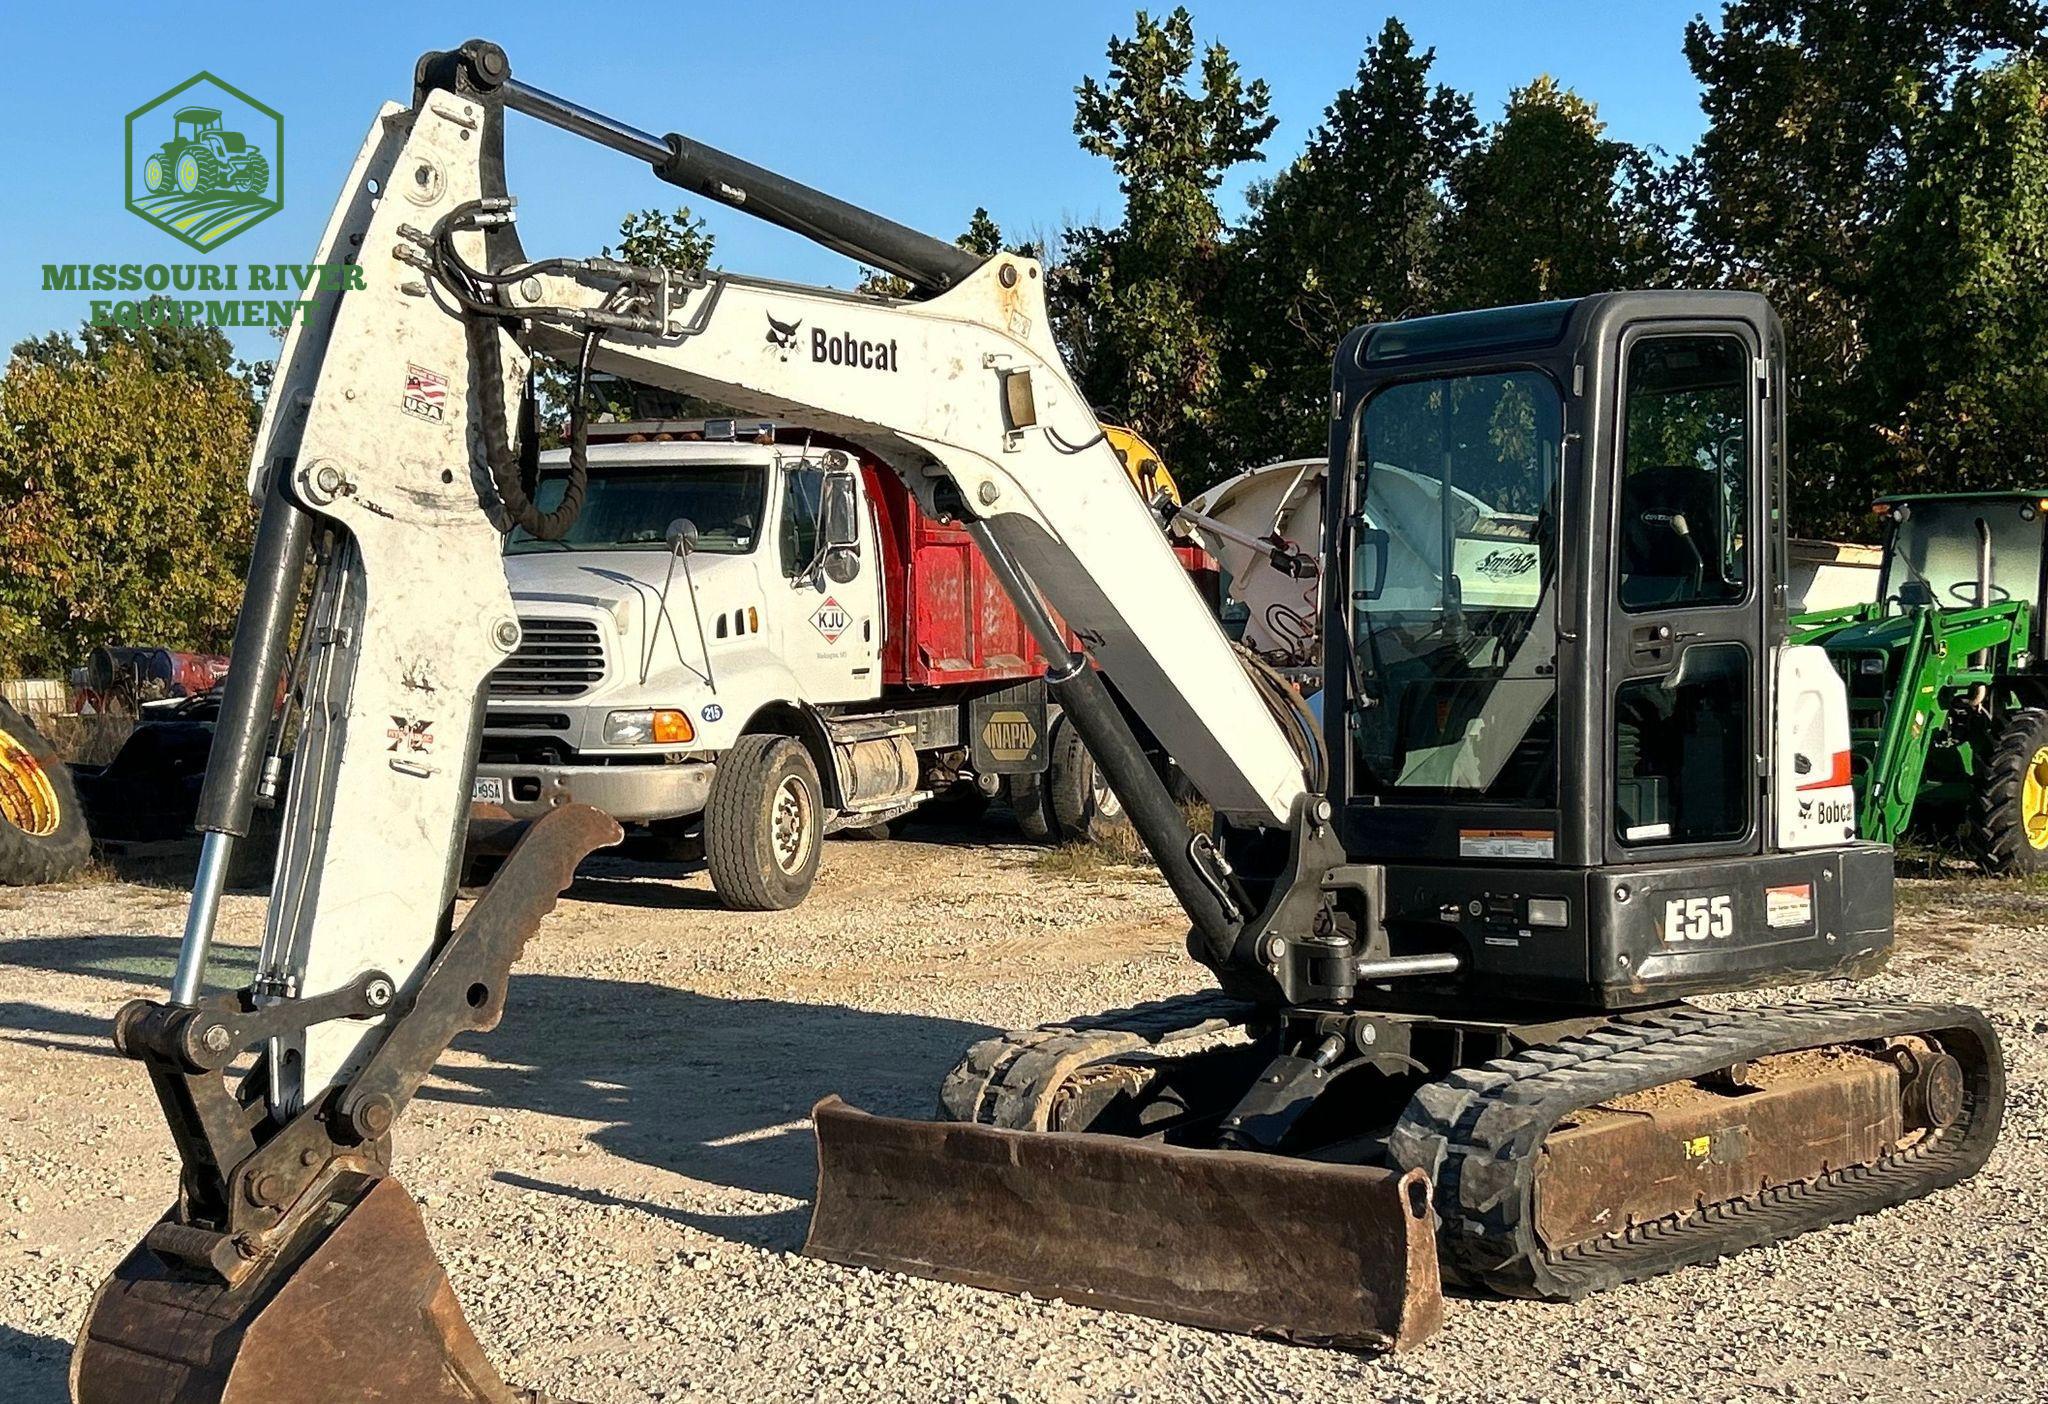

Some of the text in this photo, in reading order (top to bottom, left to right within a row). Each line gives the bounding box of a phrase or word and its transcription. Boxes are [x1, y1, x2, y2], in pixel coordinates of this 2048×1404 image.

[811, 326, 898, 373] Bobcat
[405, 397, 442, 420] USA
[818, 611, 844, 629] KJU
[704, 706, 721, 721] 215
[990, 722, 1030, 749] NAPA
[1818, 800, 1852, 825] Bobca
[1664, 895, 1734, 942] E55
